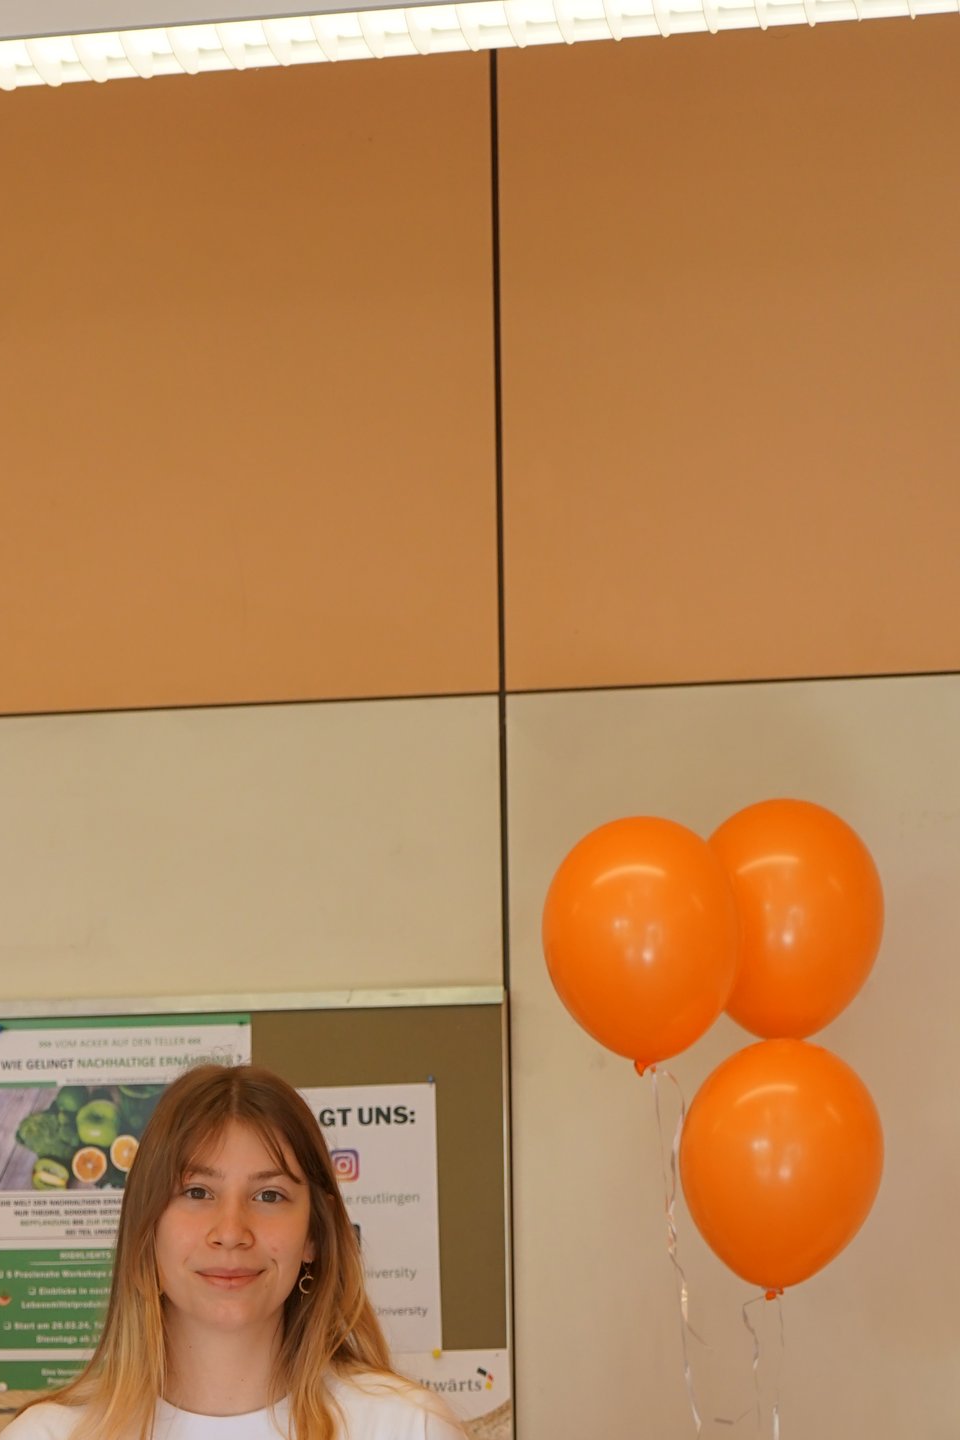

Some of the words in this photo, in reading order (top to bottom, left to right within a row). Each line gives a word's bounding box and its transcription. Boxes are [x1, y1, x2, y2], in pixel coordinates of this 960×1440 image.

[154, 1037, 186, 1046] TELLER
[1, 1059, 22, 1071] WIE
[26, 1059, 74, 1070] GELINGT
[77, 1056, 155, 1068] NACHHALTIGE
[357, 1105, 416, 1126] UNS:
[38, 1287, 77, 1296] Einblicke
[79, 1287, 88, 1296] in
[14, 1321, 35, 1331] Start
[37, 1322, 49, 1331] am
